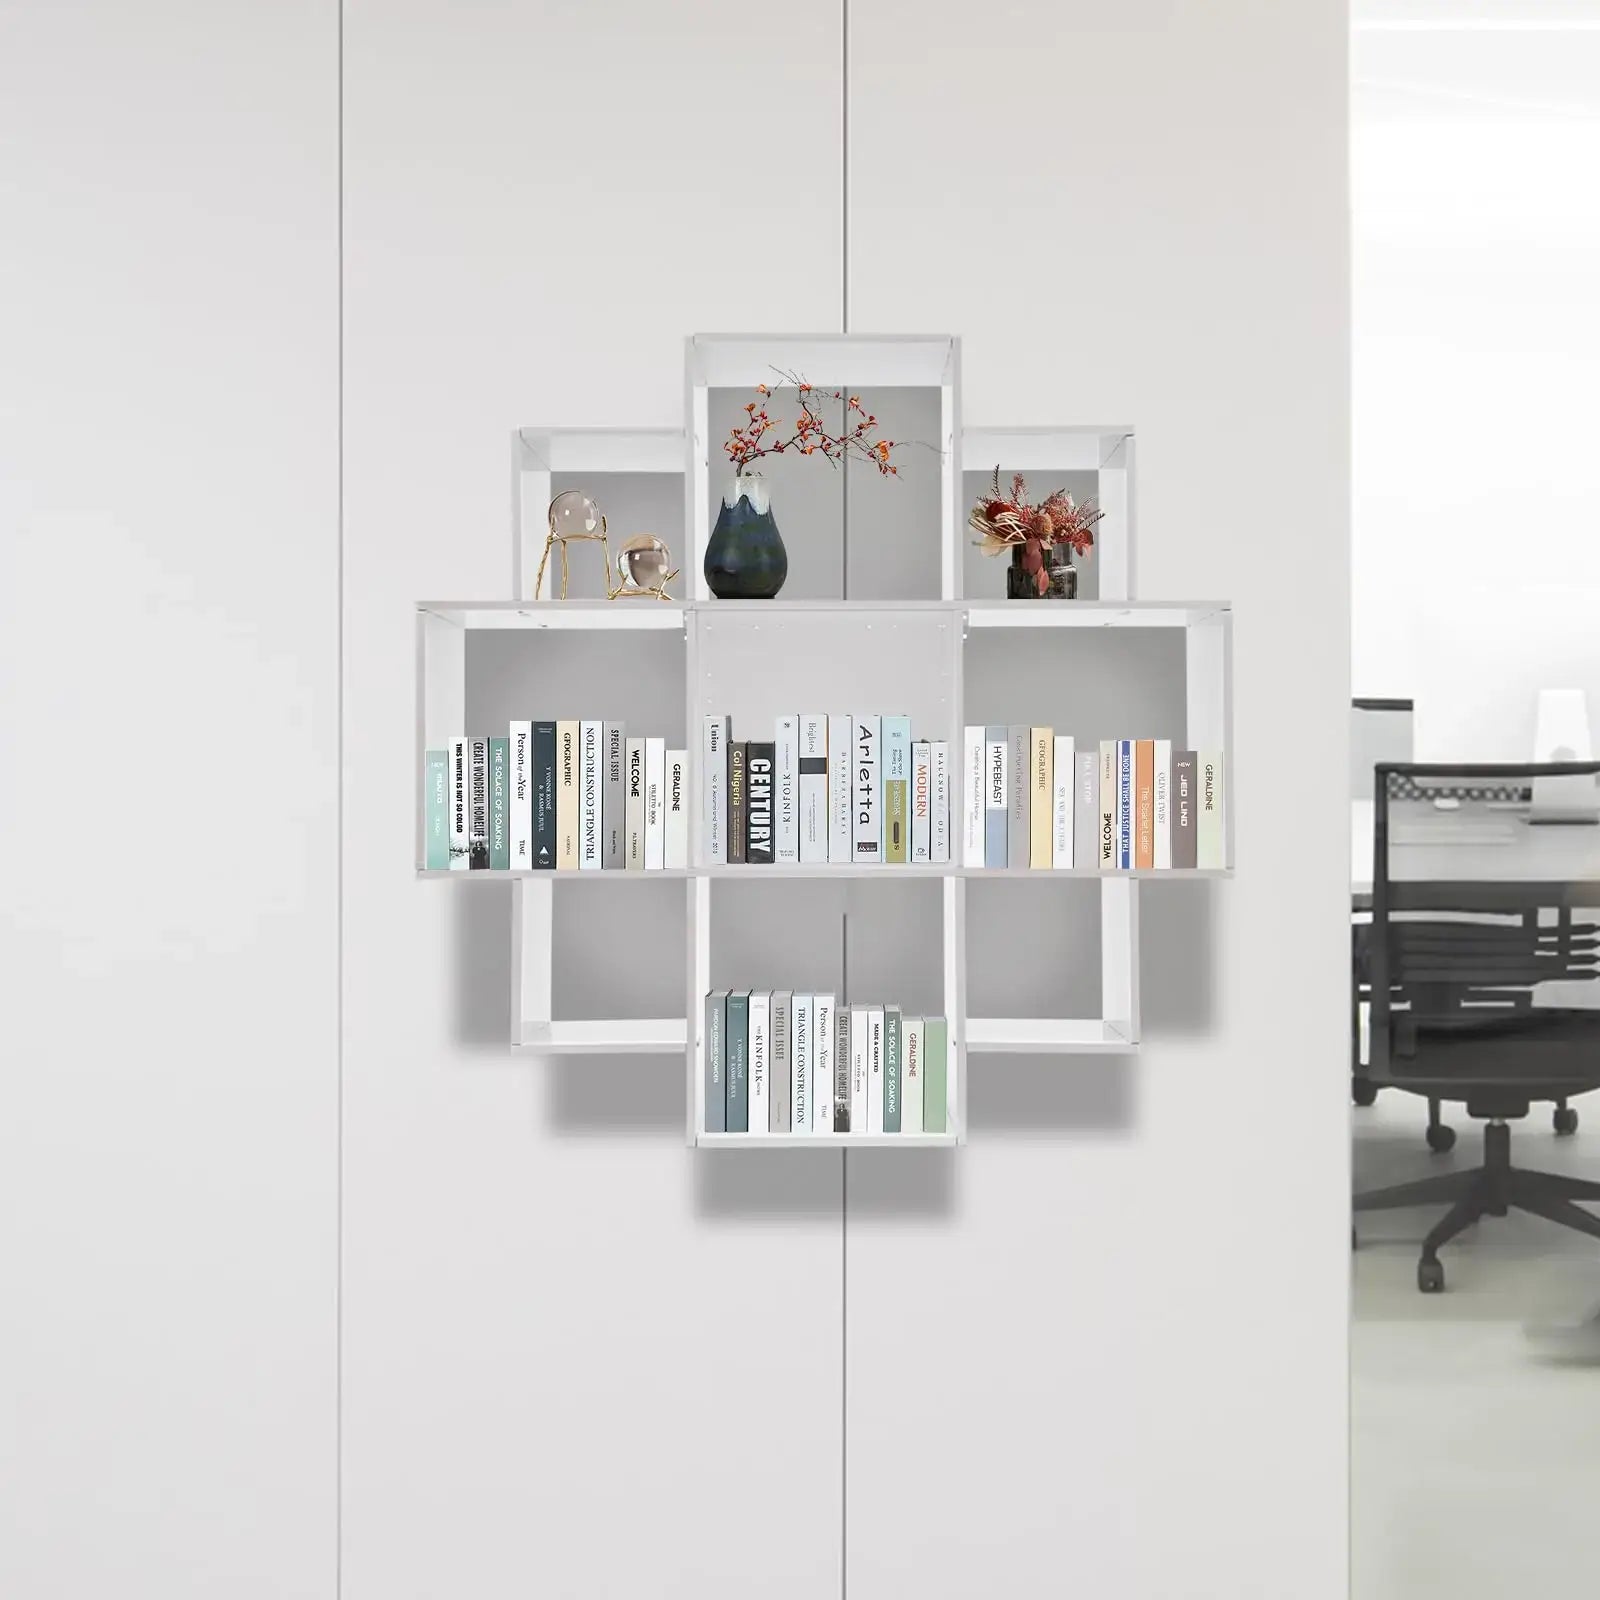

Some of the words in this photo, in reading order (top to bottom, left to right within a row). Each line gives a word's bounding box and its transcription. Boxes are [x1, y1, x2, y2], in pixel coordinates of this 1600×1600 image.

[474, 742, 484, 764] CREATE
[518, 733, 526, 765] Person
[611, 729, 619, 759] SPECIAL
[711, 724, 719, 752] Union
[586, 727, 594, 808] CONSTRUCTION
[611, 761, 619, 782] ISSUE
[632, 749, 640, 797] WELCOME
[734, 750, 742, 766] Col
[474, 766, 484, 805] WONDERFUL
[518, 779, 526, 800] Year
[732, 769, 742, 806] Nigeria
[859, 725, 874, 825] Arletta
[993, 746, 1002, 804] HYPEBEAST
[1123, 773, 1130, 782] BE
[1205, 764, 1213, 811] GERALDINE
[495, 799, 502, 810] OF
[783, 774, 791, 823] KINFOLK
[917, 764, 927, 817] MODERN
[1142, 786, 1150, 801] The
[456, 803, 463, 811] SO
[750, 759, 771, 853] CENTURY
[474, 806, 484, 837] HOMELIFE
[586, 809, 594, 860] TRIANGLE
[1104, 813, 1112, 860] WELCOME
[775, 1007, 784, 1037] SPECIAL
[839, 1016, 848, 1036] CREATE
[820, 1050, 828, 1069] Year
[839, 1037, 848, 1071] WONDERFUL
[839, 1072, 848, 1100] HOMELIFE
[889, 1067, 895, 1078] OF
